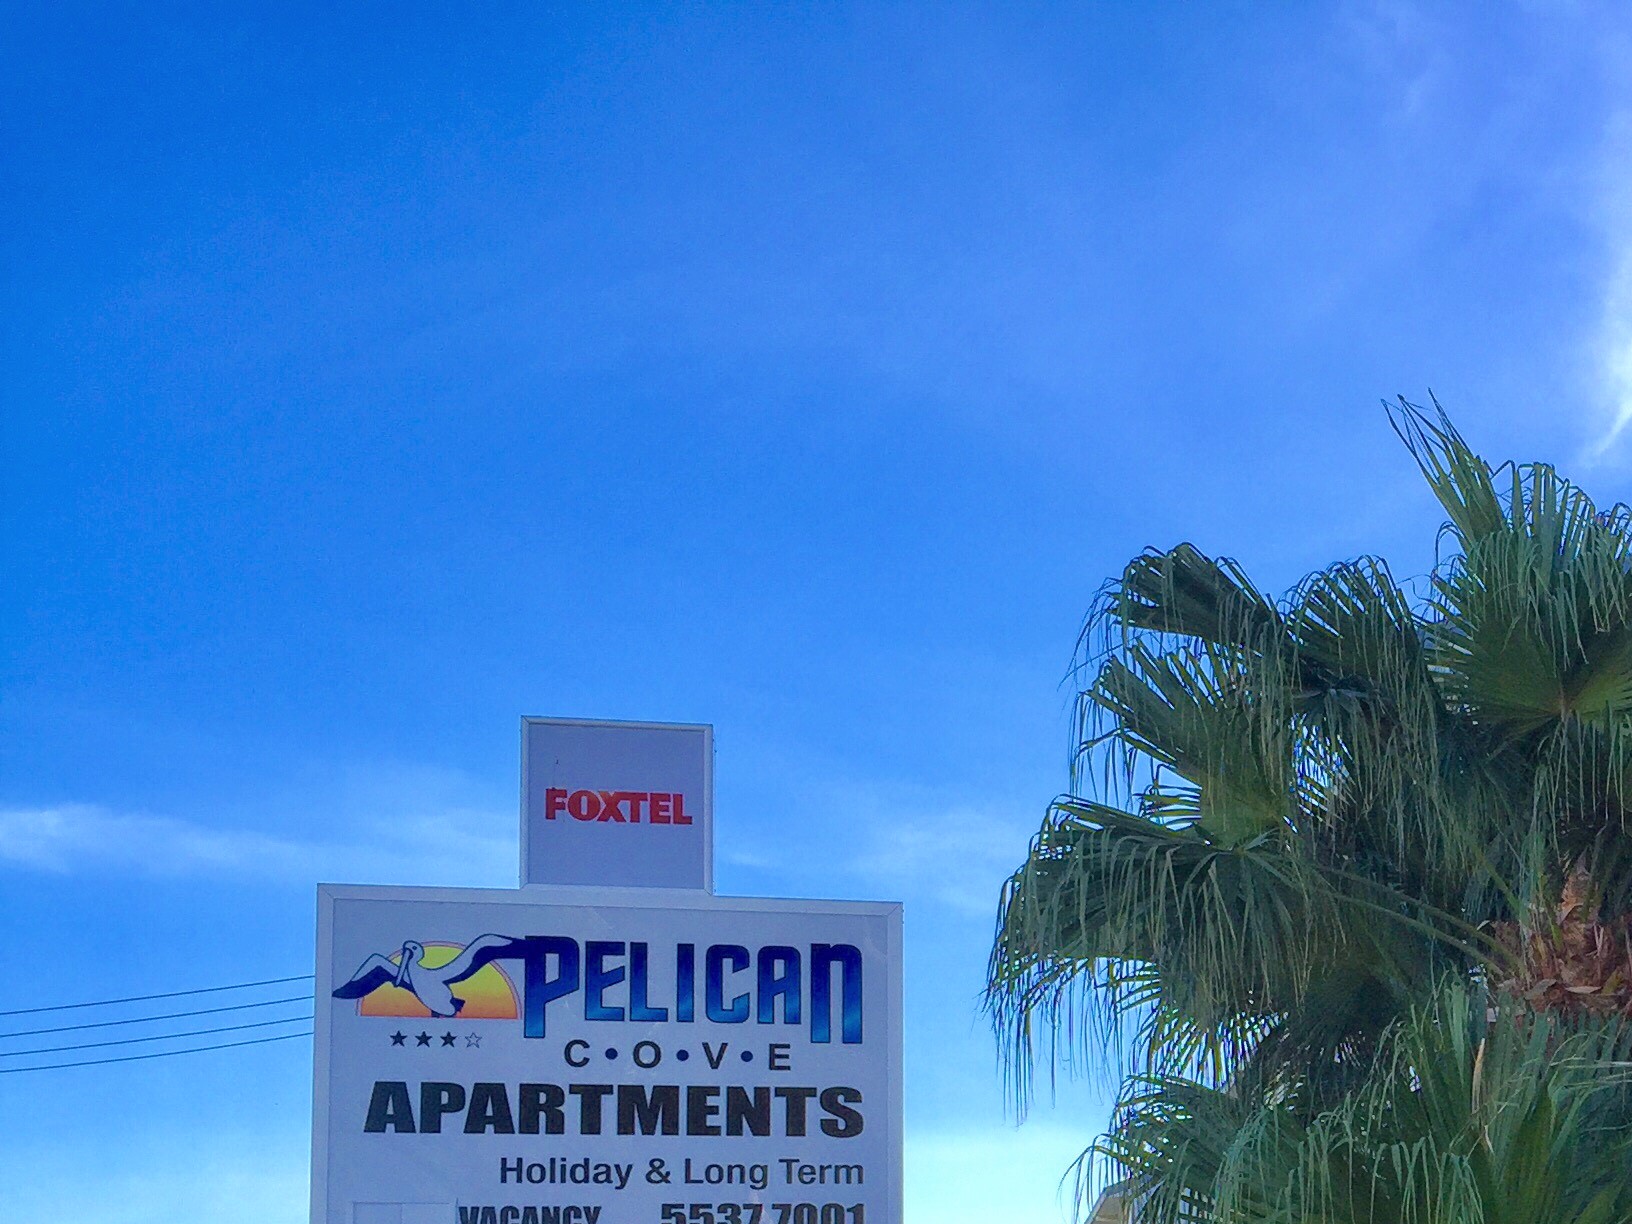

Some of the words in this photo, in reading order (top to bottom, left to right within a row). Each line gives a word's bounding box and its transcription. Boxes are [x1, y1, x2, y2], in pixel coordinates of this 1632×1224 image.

[545, 788, 693, 825] FOXTEL
[524, 935, 863, 1044] PELICAN
[363, 1081, 864, 1137] APARTMENTS
[500, 1157, 634, 1190] Holiday
[645, 1159, 671, 1184] &
[684, 1160, 769, 1190] Long
[779, 1160, 864, 1185] Term
